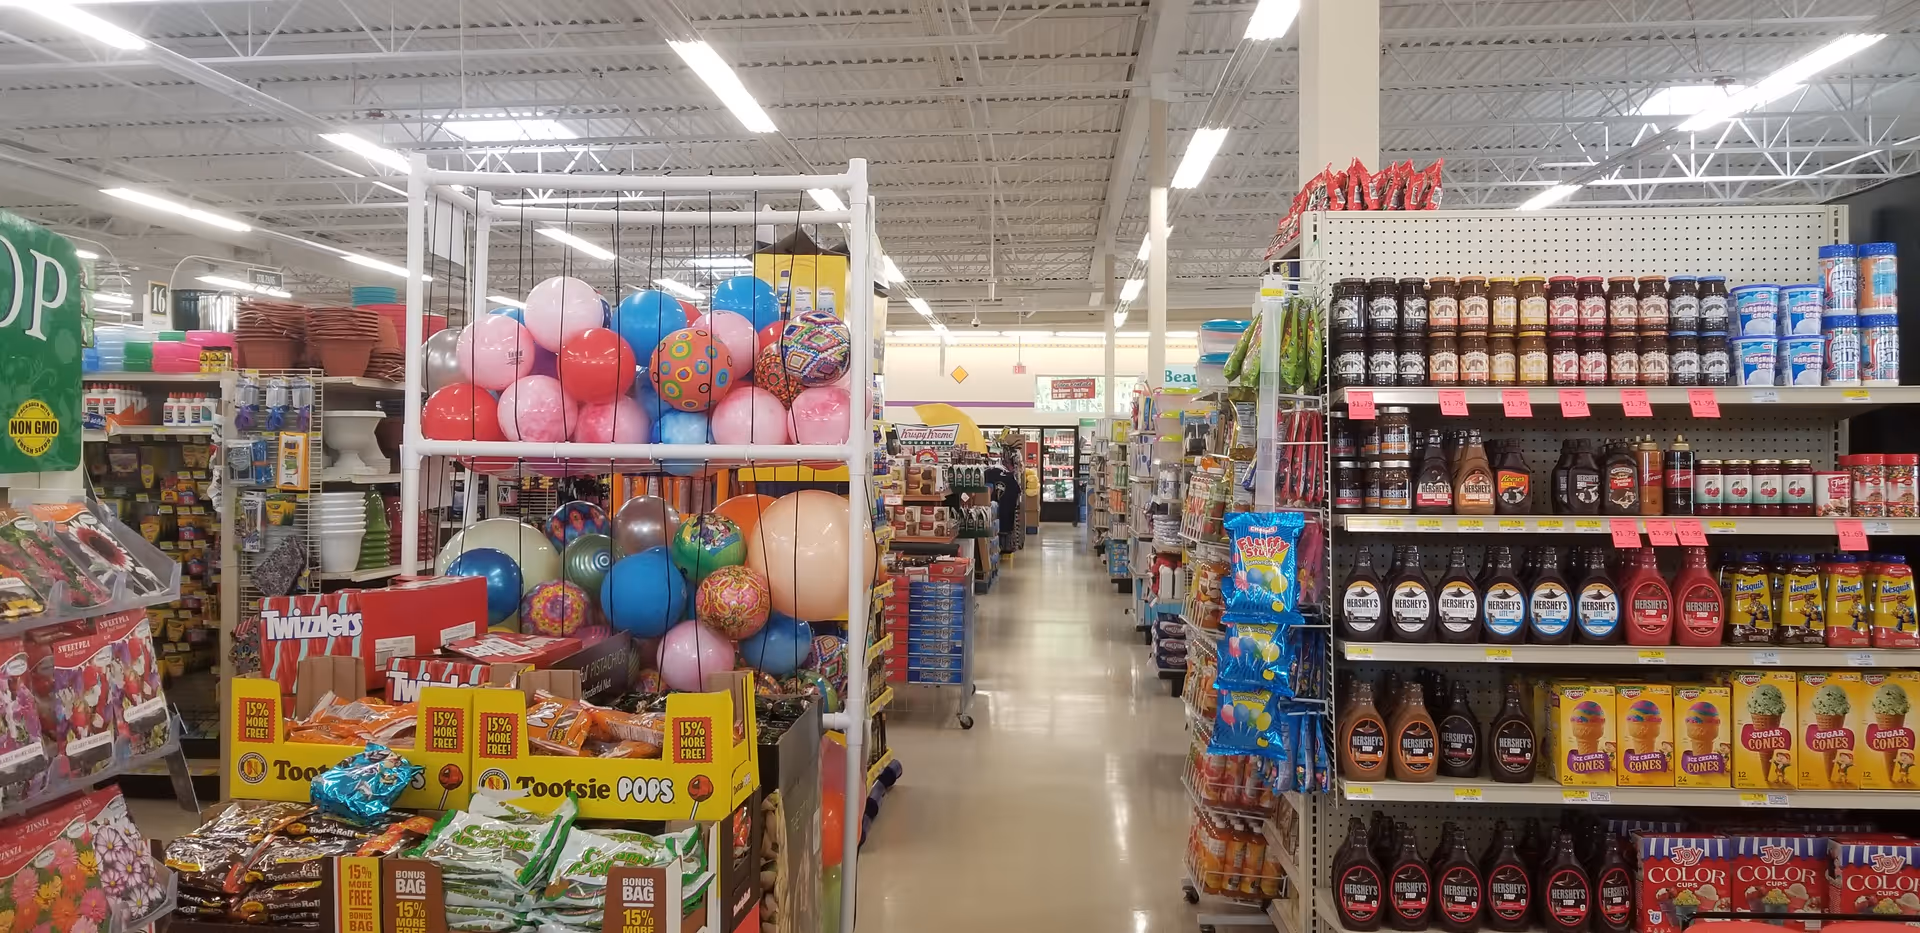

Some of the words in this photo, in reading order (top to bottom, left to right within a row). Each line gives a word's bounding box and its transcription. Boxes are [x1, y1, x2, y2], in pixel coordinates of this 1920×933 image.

[152, 286, 166, 313] 16
[1352, 400, 1373, 408] $1.79
[1507, 400, 1528, 408] $1.79
[1564, 400, 1586, 408] $1.79
[1626, 400, 1648, 408] $1.79
[10, 420, 32, 435] NON
[34, 420, 58, 435] GMO
[901, 428, 928, 442] Krispy
[926, 428, 954, 440] Kreme
[17, 438, 34, 454] FRESH
[34, 438, 51, 454] SEEDS
[1422, 484, 1450, 493] HERSHEY'S
[1464, 484, 1492, 494] HERSHEY'S
[1237, 536, 1290, 552] Fluffy
[1736, 580, 1764, 592] Nesquik
[1790, 580, 1818, 593] Nesquik
[1882, 582, 1911, 594] Nesquik
[1346, 598, 1378, 609] HERSHEY'S
[1394, 598, 1427, 609] HERSHEY'S
[1442, 598, 1474, 609] HERSHEY'S
[1488, 600, 1521, 611] HERSHEY'S
[1534, 600, 1568, 610] HERSHEY'S
[1582, 601, 1616, 612] HERSHEY'S
[1634, 599, 1668, 610] HERSHEY'S
[1686, 602, 1718, 612] HERSHEY'S
[99, 619, 119, 630] SWEET
[260, 606, 362, 640] Twizzlers
[58, 642, 78, 654] SWEET
[78, 640, 91, 649] PEA
[590, 648, 626, 678] PISTACHIOS
[246, 701, 269, 716] 15%
[246, 716, 268, 728] MORE
[433, 711, 458, 726] 15%
[487, 716, 512, 732] 15%
[246, 728, 268, 738] FREE!
[433, 726, 457, 738] MORE
[680, 720, 706, 736] 15%
[1752, 730, 1781, 738] SUGAR
[1816, 730, 1845, 738] SUGAR
[1876, 730, 1905, 738] SUGAR
[433, 737, 457, 750] FREE!
[487, 732, 512, 744] MORE
[680, 736, 705, 748] MORE
[1352, 736, 1384, 746] HERSHEY'S
[1402, 738, 1434, 748] HERSHEY'S
[1442, 732, 1474, 743] HERSHEY'S
[1499, 738, 1532, 748] HERSHEY'S
[1748, 737, 1785, 750] CONES
[1872, 737, 1909, 750] CONES
[487, 744, 512, 756] FREE!
[1812, 738, 1849, 750] CONES
[680, 748, 705, 760] FREE!
[1572, 754, 1583, 762] ICE
[1584, 754, 1604, 762] CREAM
[1630, 754, 1639, 762] ICE
[1640, 754, 1661, 762] CREAM
[273, 760, 329, 782] Toot
[1572, 760, 1605, 771] CONES
[1630, 760, 1662, 771] CONES
[1687, 761, 1719, 772] CONES
[1620, 774, 1630, 782] 24
[516, 776, 610, 802] Tootsie
[616, 776, 674, 804] POPS
[25, 818, 50, 834] ZINNIA
[336, 826, 354, 838] Roll
[348, 864, 372, 880] 15%
[396, 870, 426, 879] BONUS
[1648, 867, 1726, 885] COLOR
[1737, 866, 1816, 884] COLOR
[348, 880, 372, 888] MORE
[396, 878, 426, 894] BAG
[622, 878, 654, 886] BONUS
[1394, 882, 1428, 894] HERSHEY'S
[622, 886, 654, 902] BAG
[1344, 884, 1378, 896] HERSHEY'S
[1444, 884, 1478, 897] HERSHEY'S
[1492, 883, 1526, 895] HERSHEY'S
[1552, 888, 1586, 900] HERSHEY'S
[1602, 886, 1630, 898] HERSHEY'S
[348, 890, 372, 906] FREE
[348, 912, 372, 920] BONUS
[396, 902, 426, 918] 15%
[396, 918, 426, 928] MORE
[622, 910, 654, 926] 15%
[1651, 913, 1660, 922] 18
[348, 920, 373, 932] BAG
